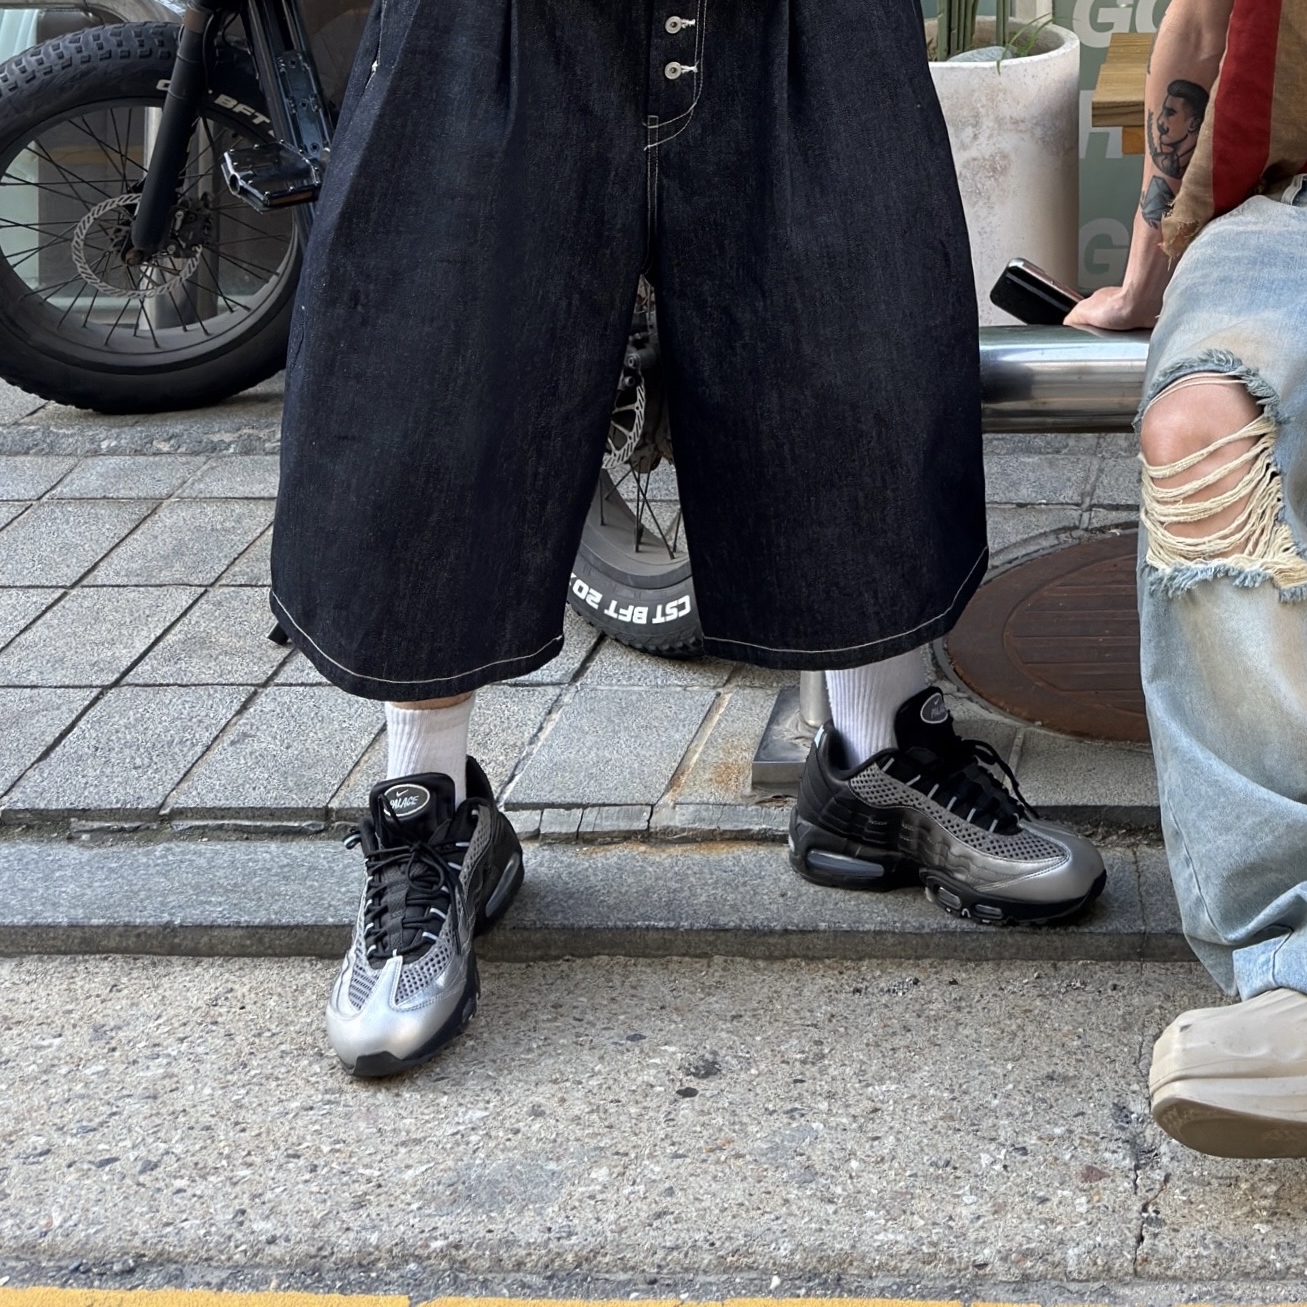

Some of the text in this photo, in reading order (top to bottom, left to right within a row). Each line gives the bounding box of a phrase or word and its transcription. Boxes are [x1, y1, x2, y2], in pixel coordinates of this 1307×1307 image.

[569, 573, 691, 624] CST BFT 20
[390, 795, 419, 809] PALACE
